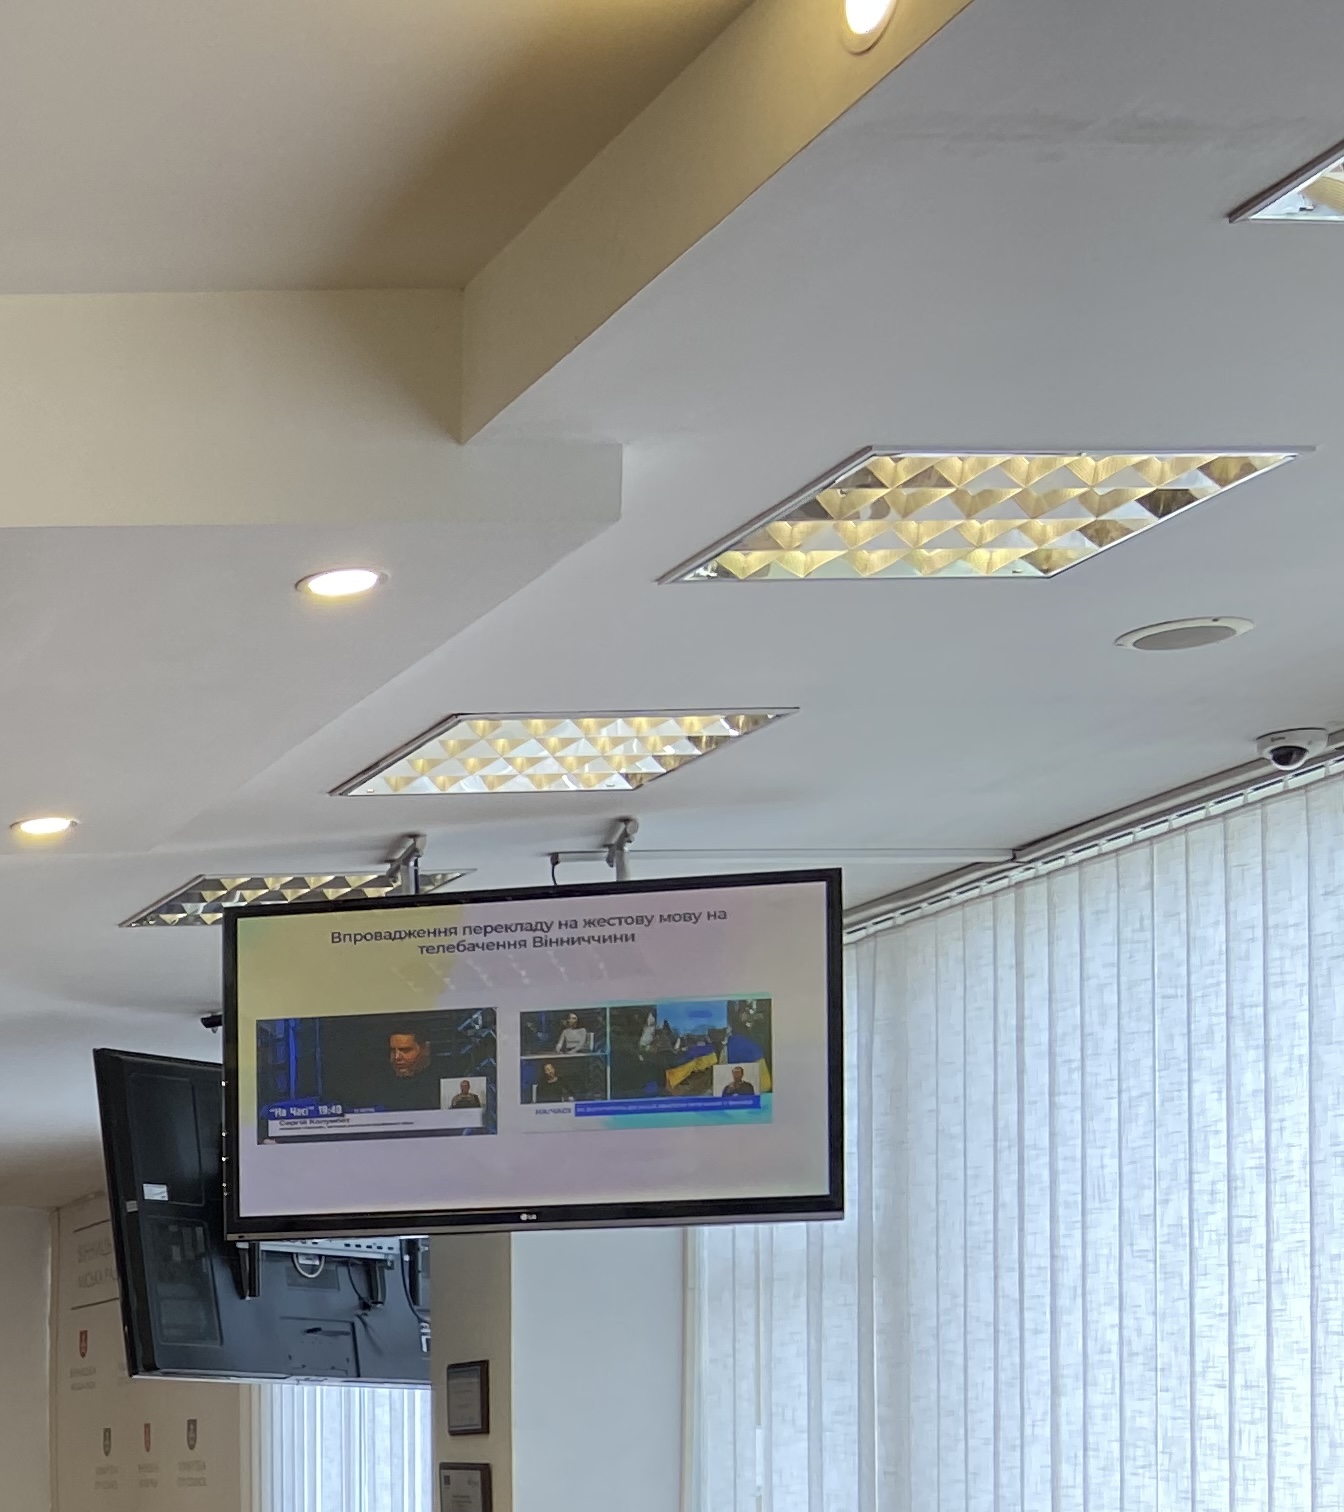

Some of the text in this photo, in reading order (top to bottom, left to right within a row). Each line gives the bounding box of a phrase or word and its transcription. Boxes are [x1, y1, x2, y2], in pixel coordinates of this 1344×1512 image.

[331, 910, 728, 945] Впровадження перекладу на жестову мову на
[419, 931, 636, 955] телебачення Вінниччини
